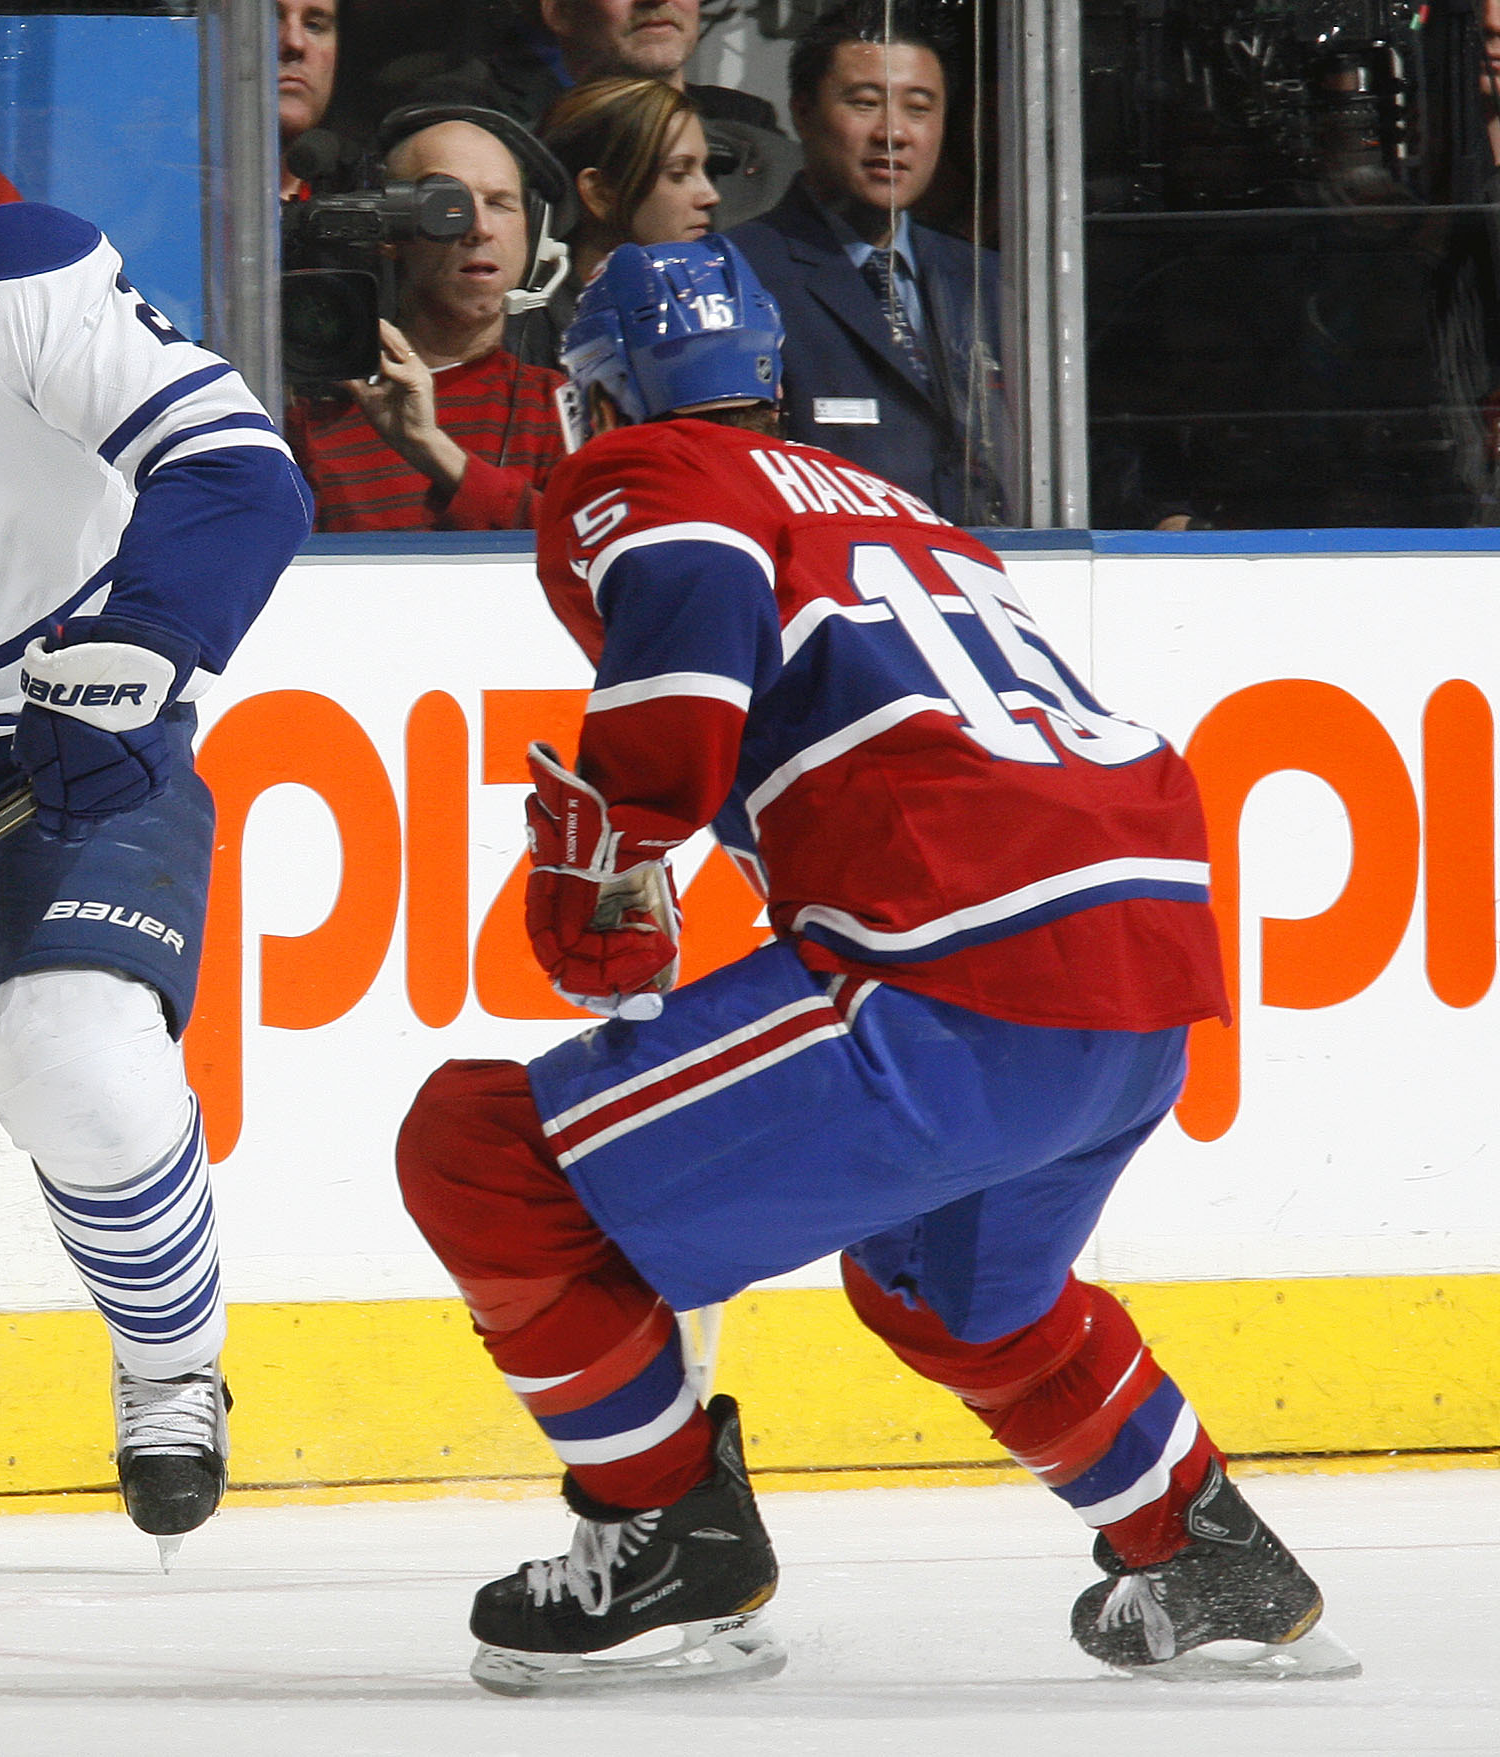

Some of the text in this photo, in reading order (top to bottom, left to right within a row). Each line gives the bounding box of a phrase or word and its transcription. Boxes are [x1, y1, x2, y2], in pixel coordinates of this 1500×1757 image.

[689, 294, 734, 329] 15
[750, 449, 954, 527] HALPE
[848, 542, 1167, 768] 15
[42, 900, 186, 956] BAUER
